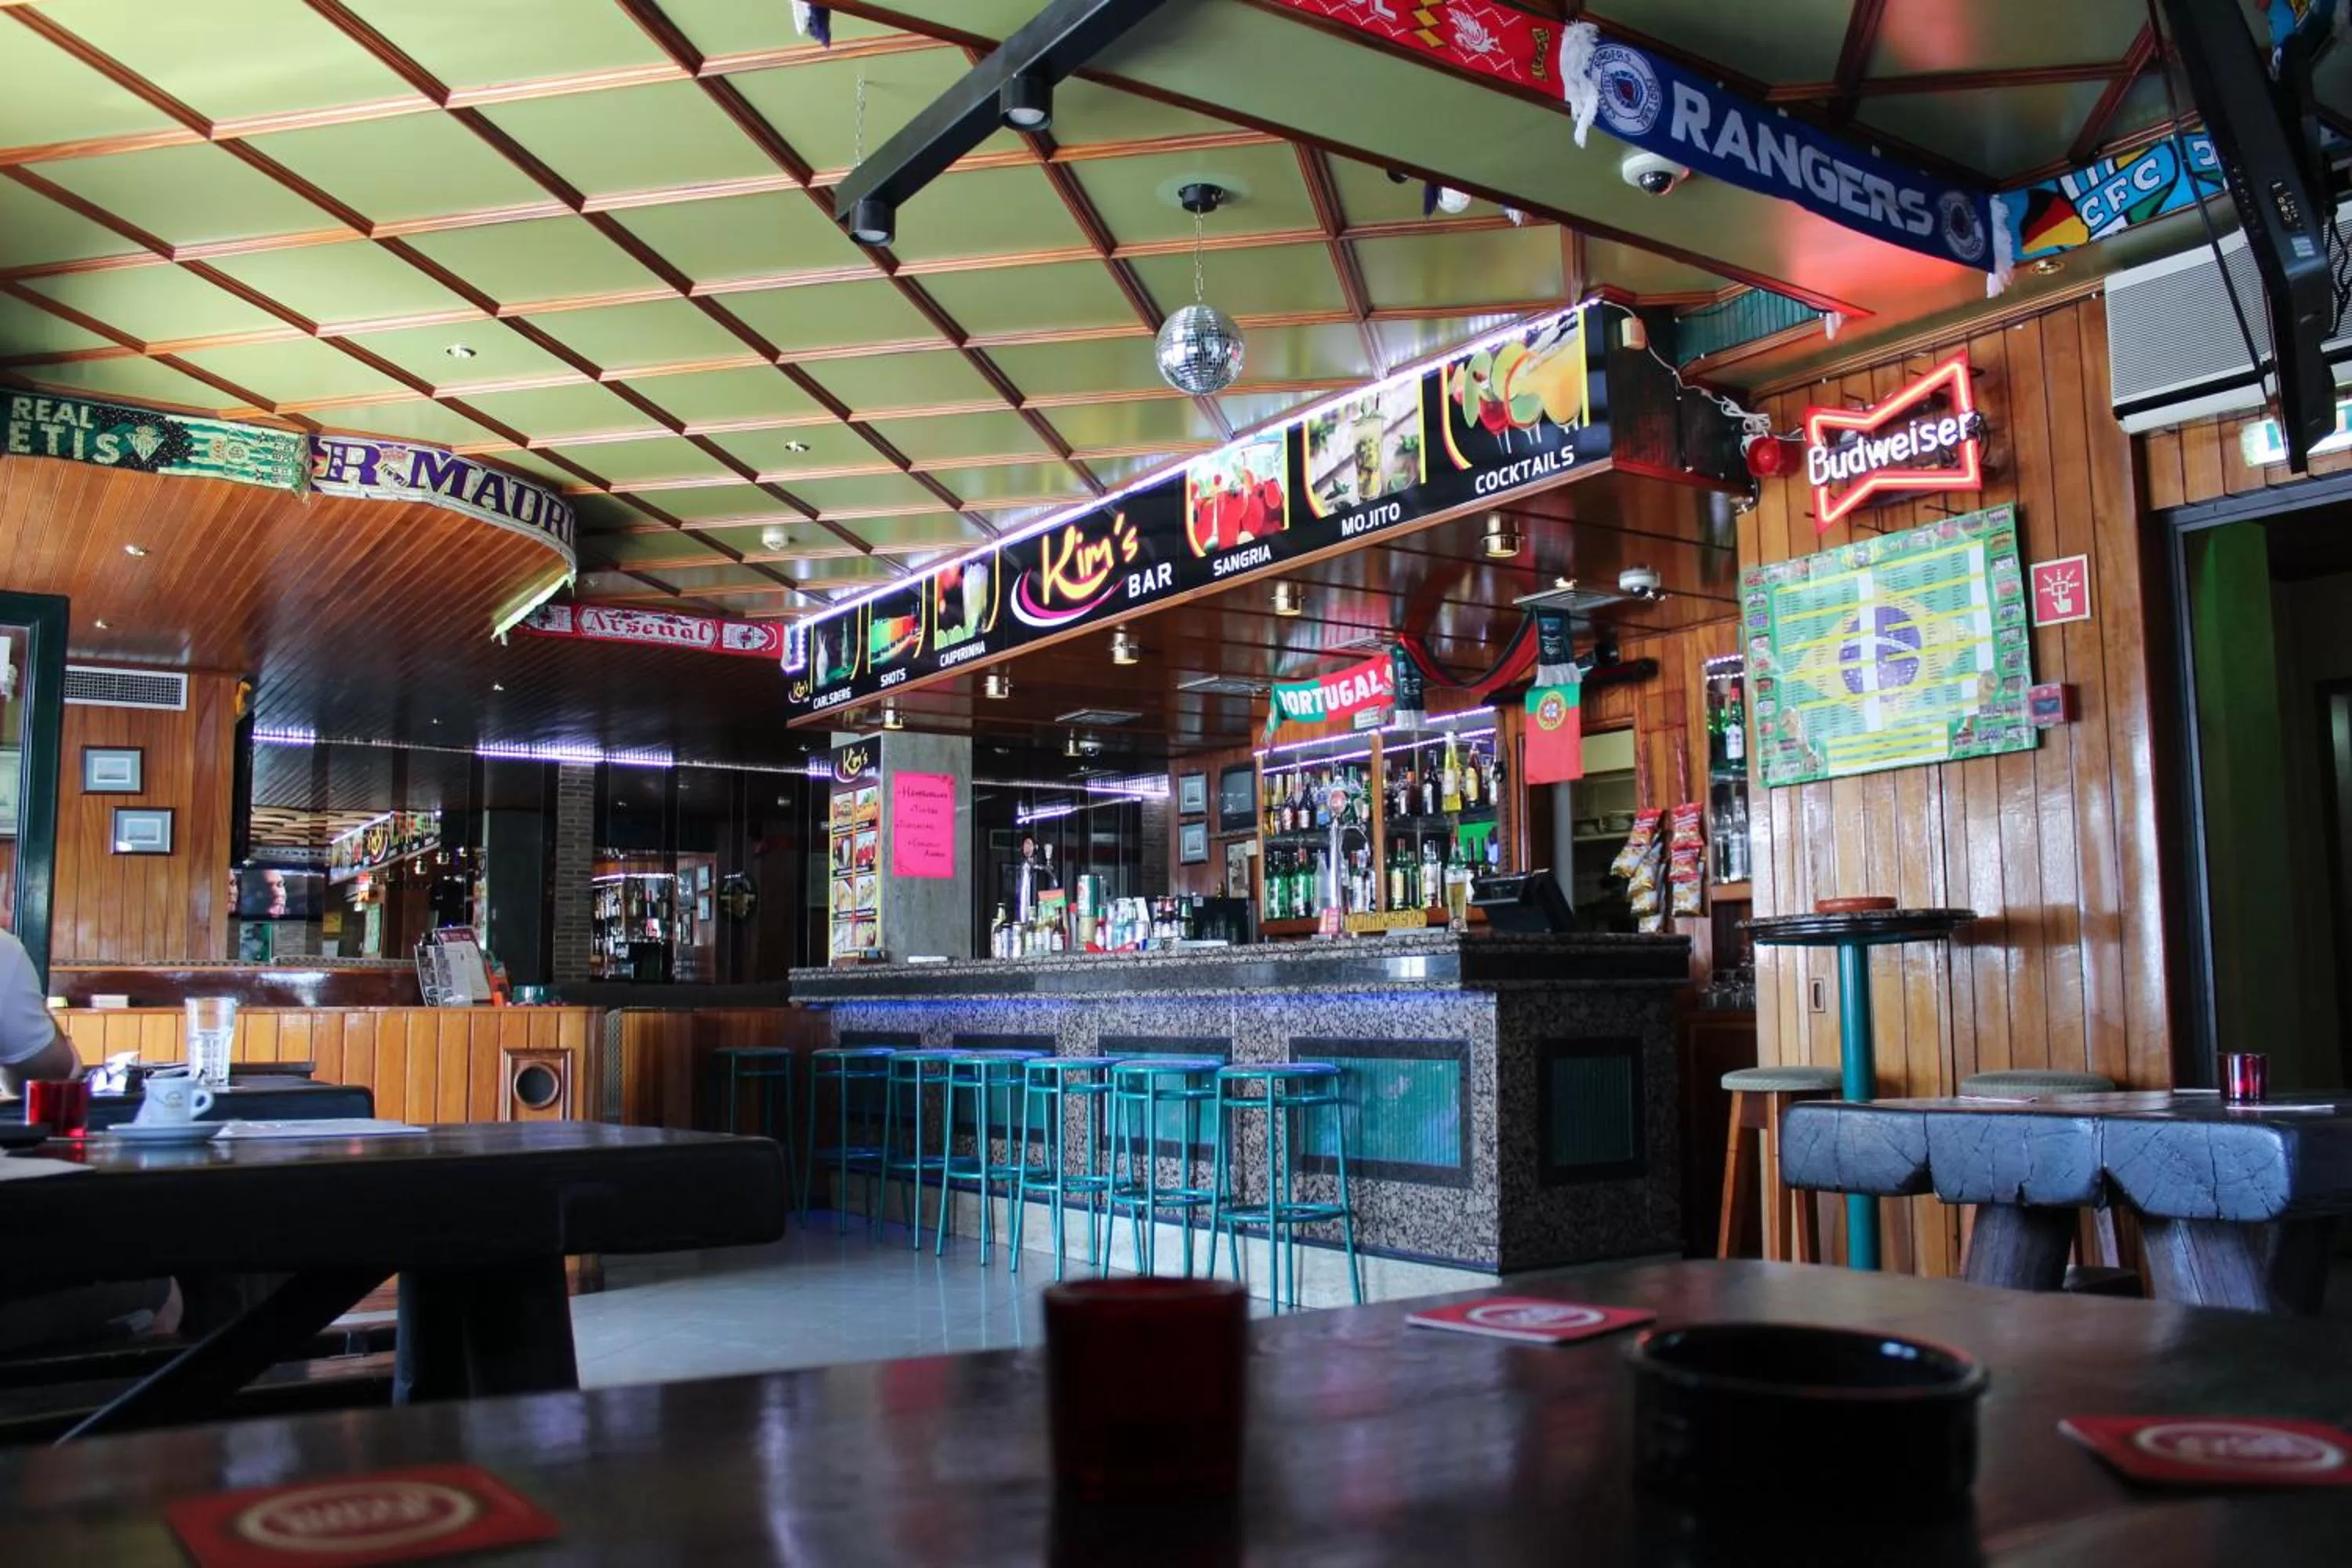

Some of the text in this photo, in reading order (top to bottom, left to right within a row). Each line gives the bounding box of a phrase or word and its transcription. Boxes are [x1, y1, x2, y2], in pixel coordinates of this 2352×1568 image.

[1671, 81, 1934, 236] RANGERS
[2081, 158, 2161, 227] CFC
[11, 396, 94, 429] REAL
[1807, 408, 1974, 486] Budweiser
[1475, 445, 1575, 495] COCKTAILS
[1341, 503, 1401, 537] MOJITO
[1041, 512, 1173, 604] Kim's BAR
[1213, 544, 1272, 576] SANGRIA
[586, 610, 708, 641] Arsenal
[880, 667, 906, 688] SHOTS
[813, 687, 852, 710] CARLSBERG
